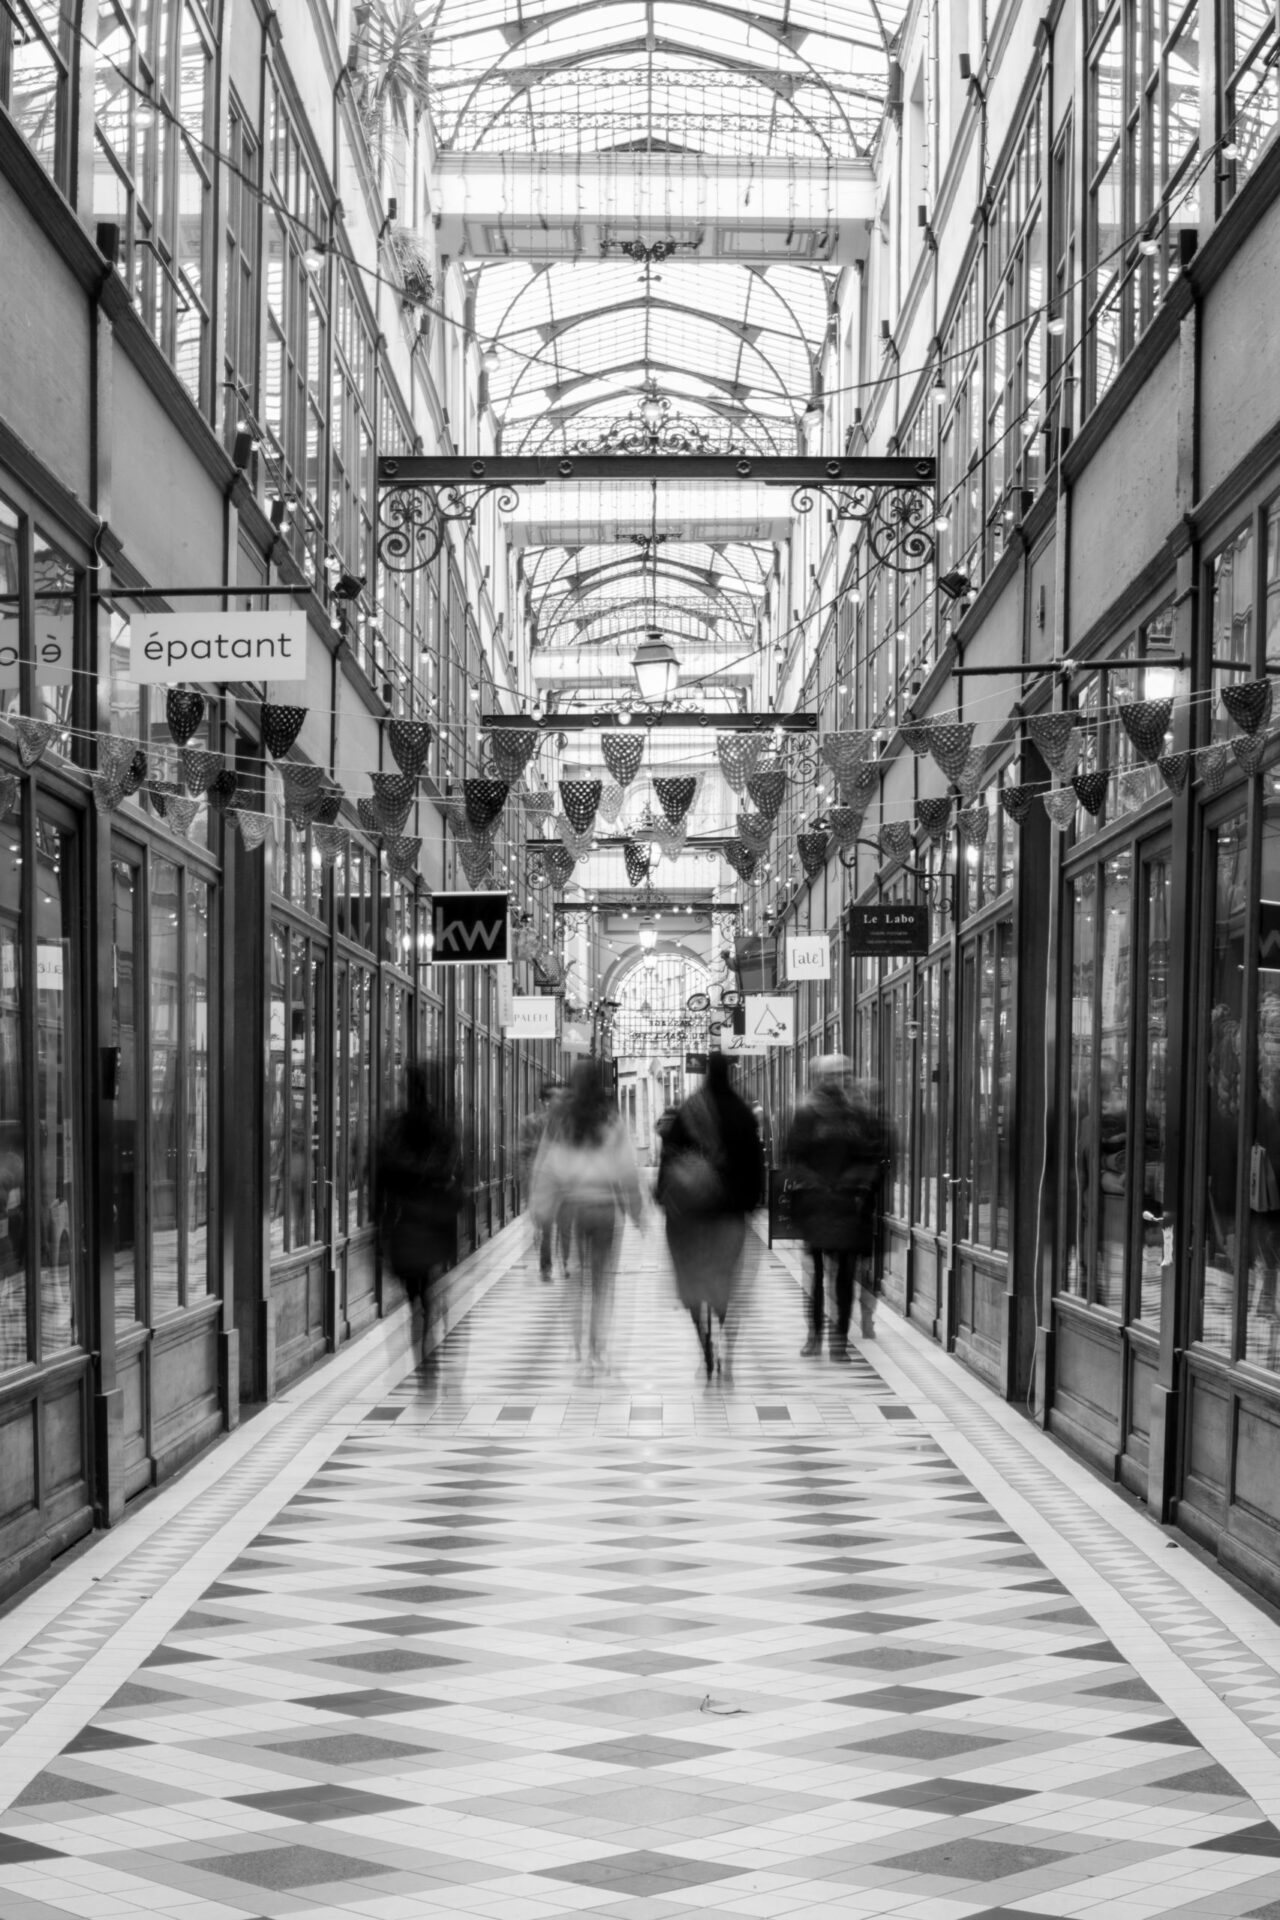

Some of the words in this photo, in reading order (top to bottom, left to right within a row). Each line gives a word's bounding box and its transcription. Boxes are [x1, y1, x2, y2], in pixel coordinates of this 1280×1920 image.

[144, 631, 292, 667] épatant
[436, 906, 503, 951] kw
[863, 914, 878, 924] Le
[885, 914, 915, 924] Labo
